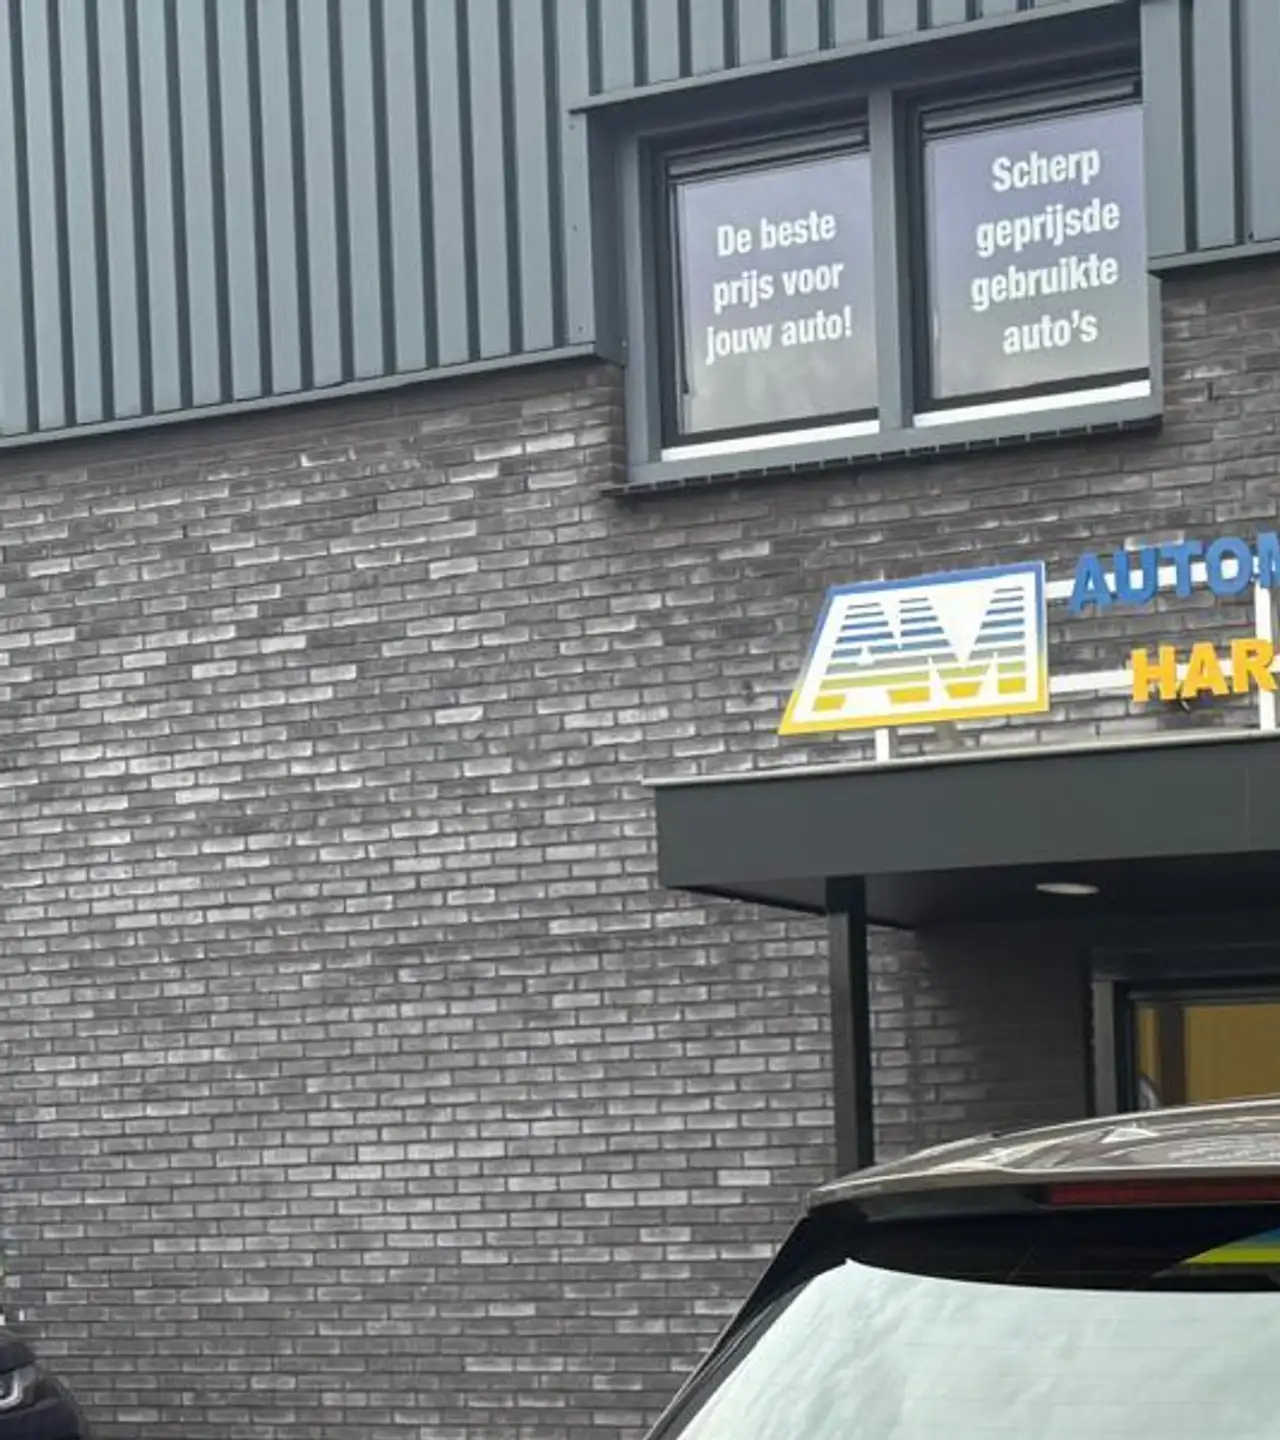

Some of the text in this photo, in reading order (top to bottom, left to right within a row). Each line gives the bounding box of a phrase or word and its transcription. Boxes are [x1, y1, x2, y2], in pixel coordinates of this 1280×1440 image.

[991, 148, 1100, 193] Scherp
[717, 210, 837, 258] De beste
[976, 198, 1120, 257] geprijsde
[713, 260, 844, 314] prijs voor
[971, 255, 1118, 312] gebruikte
[705, 305, 852, 366] jouw auto!
